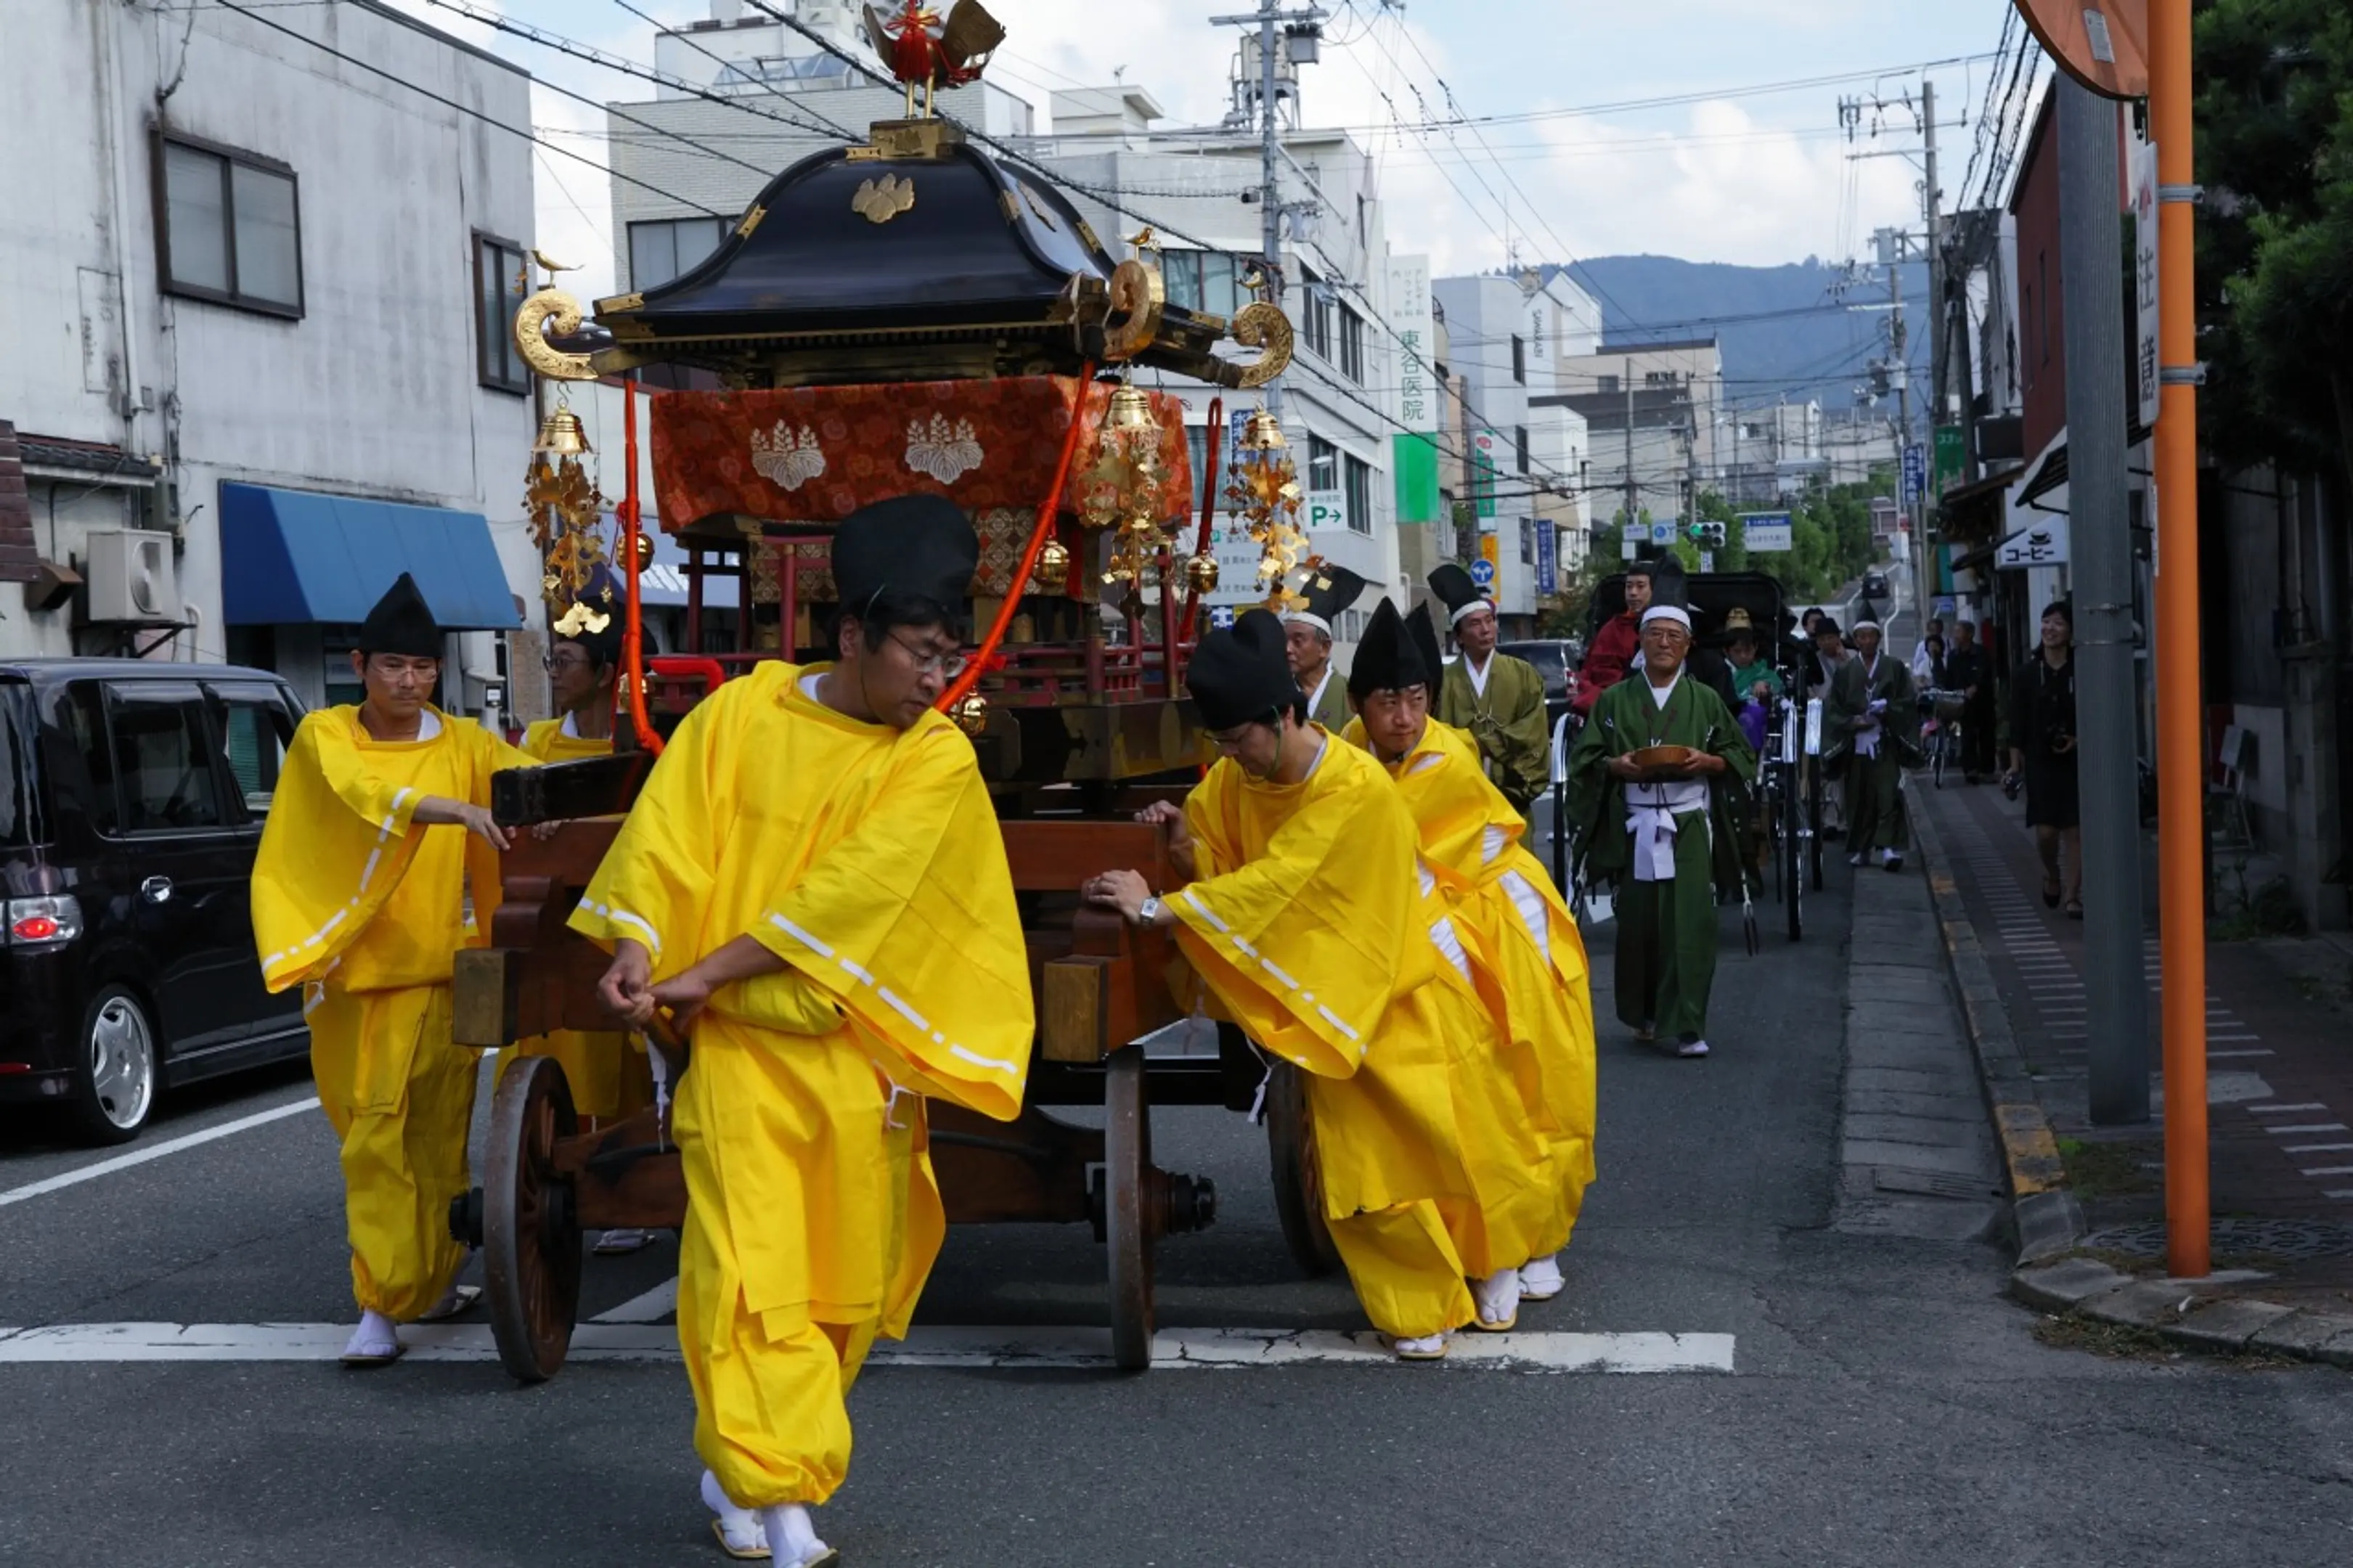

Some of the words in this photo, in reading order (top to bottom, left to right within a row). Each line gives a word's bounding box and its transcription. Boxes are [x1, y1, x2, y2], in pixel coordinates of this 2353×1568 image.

[2139, 247, 2156, 404] 注意
[1400, 330, 1424, 421] 東谷医院
[1311, 506, 1328, 526] P
[2006, 548, 2055, 561] コーヒー
